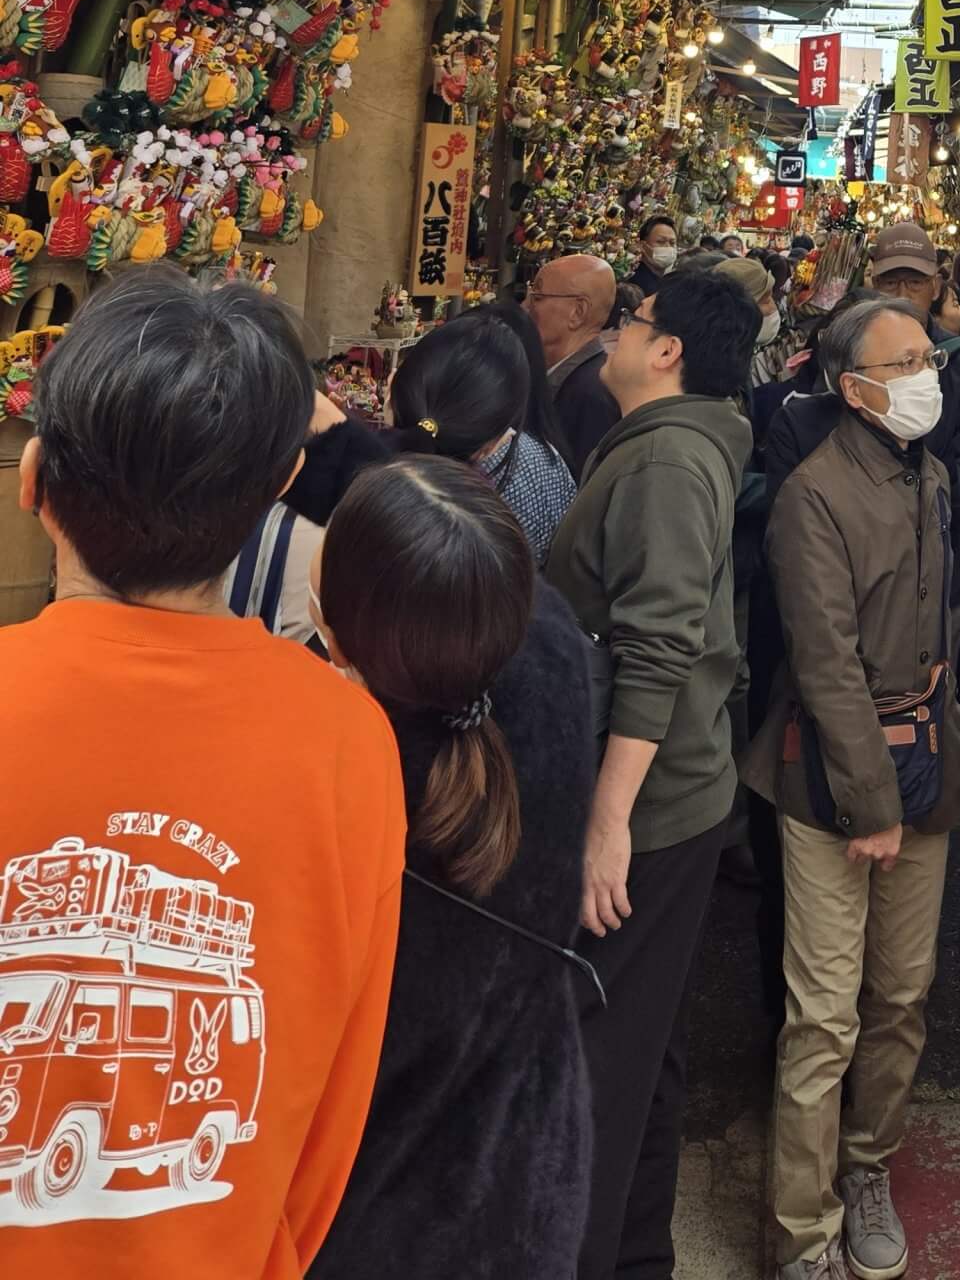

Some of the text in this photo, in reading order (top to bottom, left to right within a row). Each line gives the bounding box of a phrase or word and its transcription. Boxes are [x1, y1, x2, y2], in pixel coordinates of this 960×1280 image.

[810, 52, 829, 99] 西野
[106, 812, 241, 876] STAY CRAZY
[168, 1077, 223, 1106] DOD
